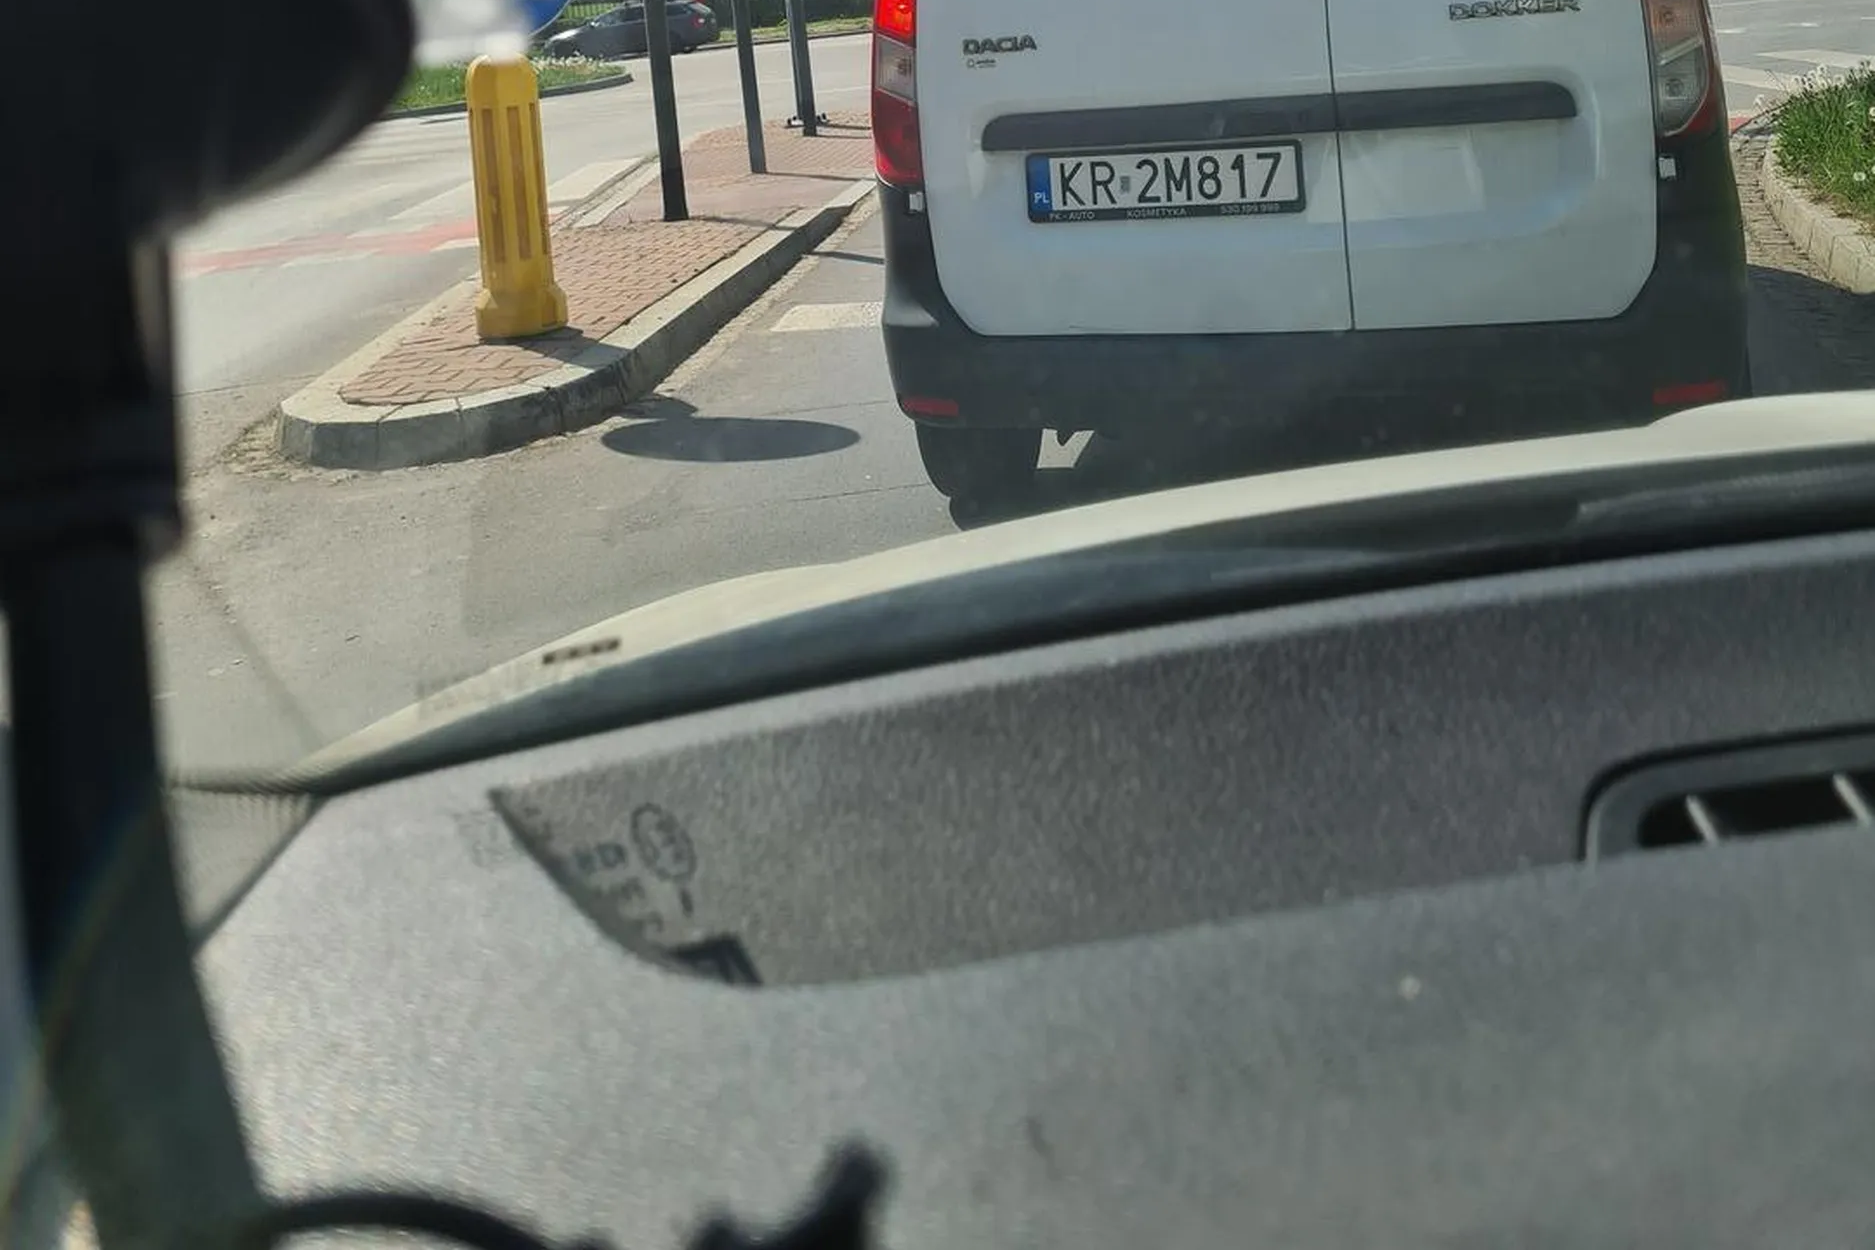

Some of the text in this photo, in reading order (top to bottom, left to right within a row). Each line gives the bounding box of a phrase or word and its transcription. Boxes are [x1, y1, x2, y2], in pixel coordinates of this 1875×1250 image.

[962, 34, 1037, 55] DACIA
[1059, 152, 1282, 207] KR 2M817
[1034, 192, 1050, 204] PL
